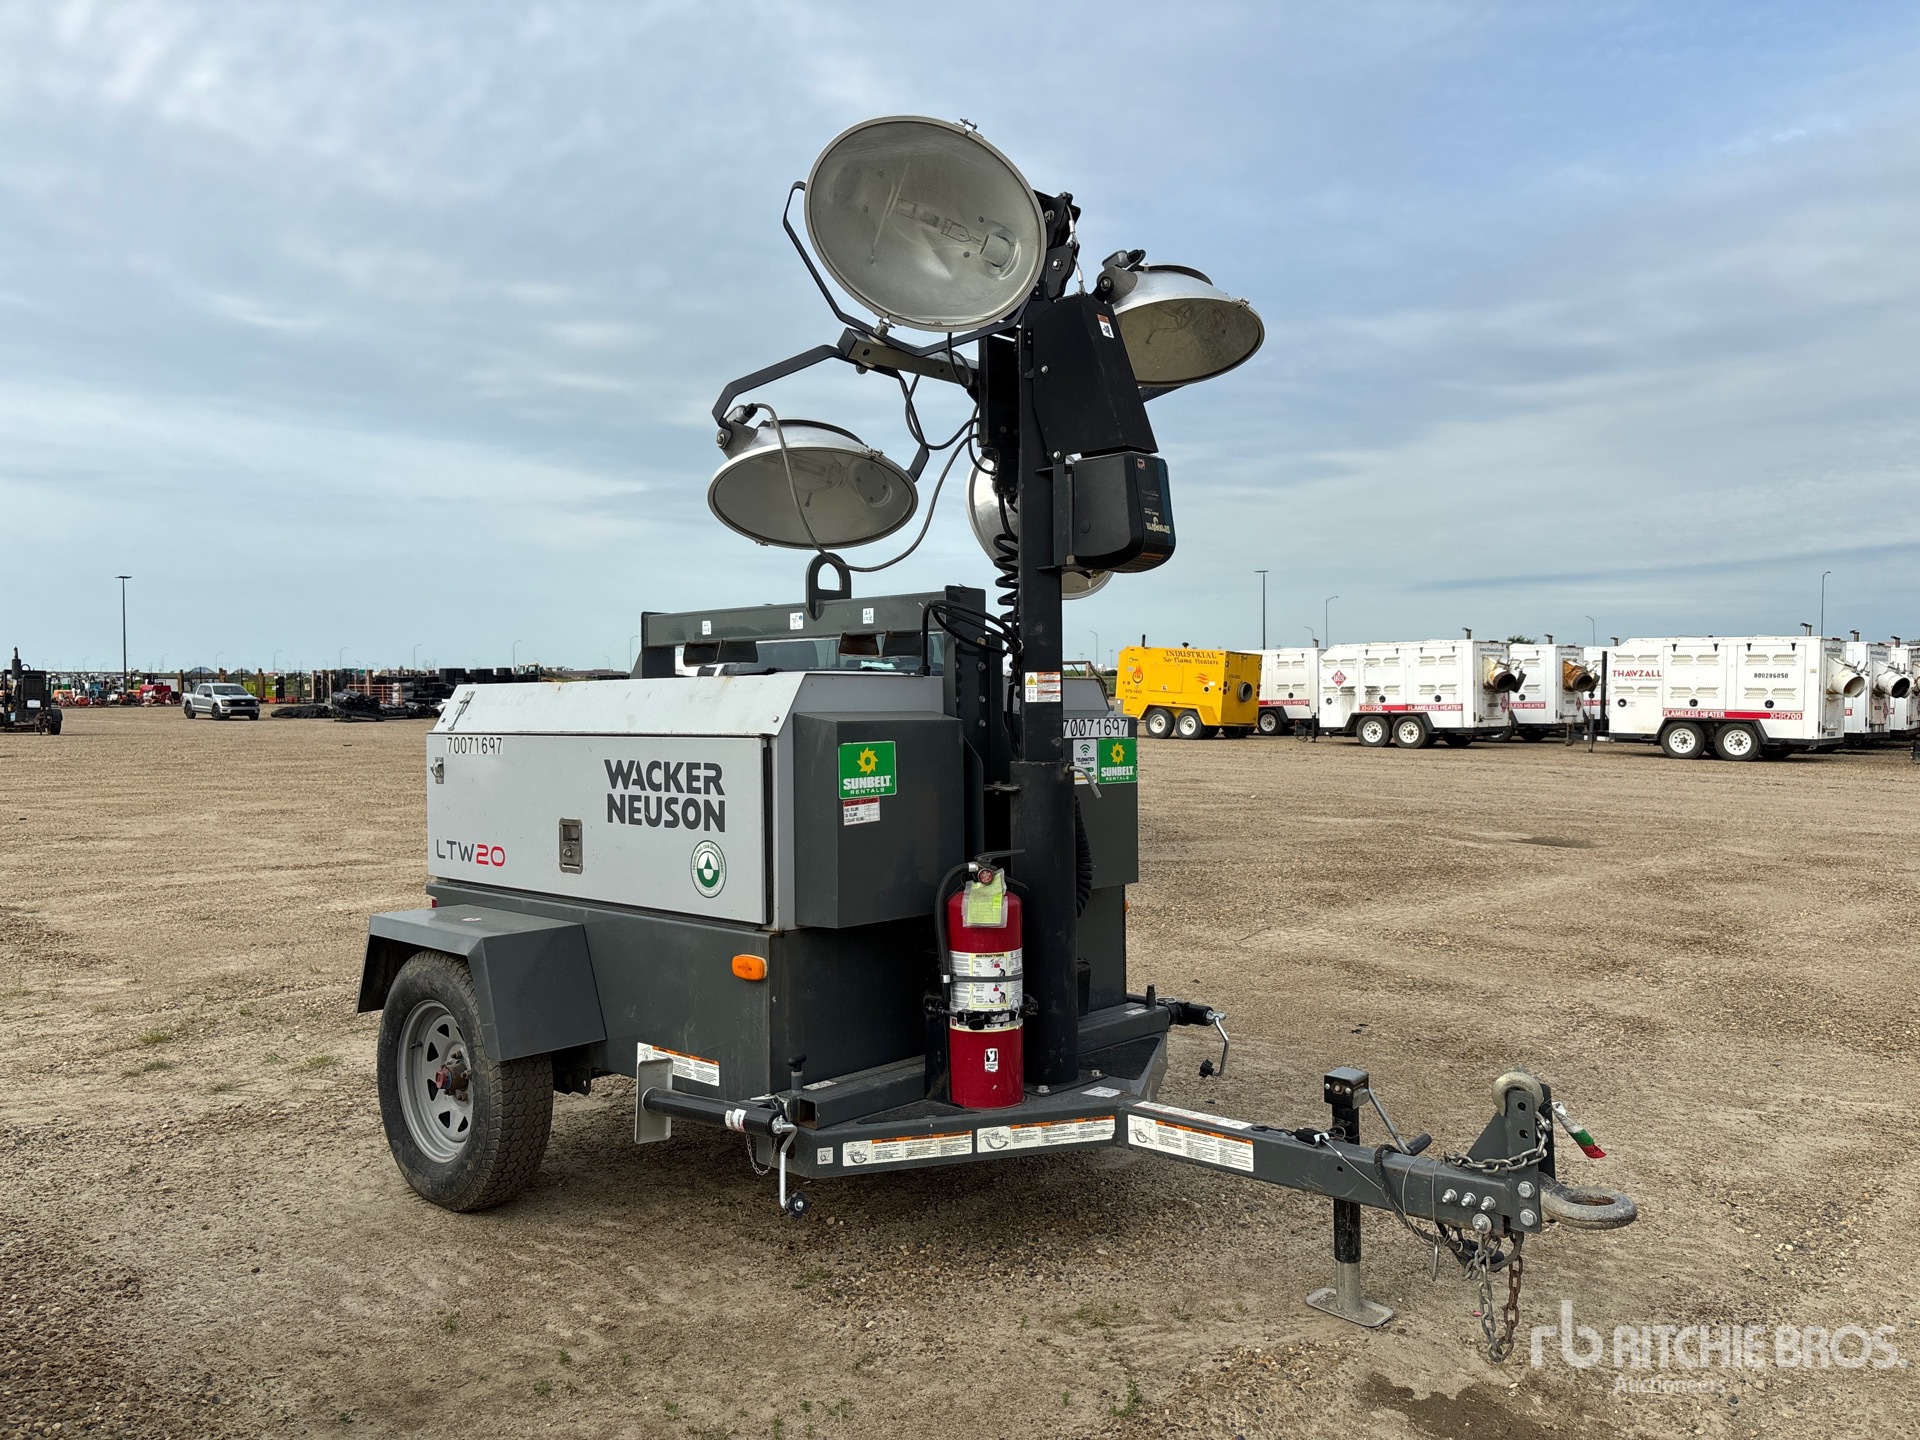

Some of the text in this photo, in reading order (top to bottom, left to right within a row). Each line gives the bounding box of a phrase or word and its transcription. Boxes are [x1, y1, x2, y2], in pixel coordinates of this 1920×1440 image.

[1165, 650, 1217, 659] INDUSTRIAL
[1612, 669, 1662, 678] THAWZALL
[1769, 712, 1801, 720] XHR700
[1063, 718, 1127, 737] 70071697
[447, 737, 502, 754] 70071697
[604, 759, 725, 795] WACKER
[1101, 766, 1134, 777] SUNBELT
[843, 775, 892, 790] SUNBELT
[607, 793, 725, 833] NEUSON
[436, 839, 506, 867] LTW20
